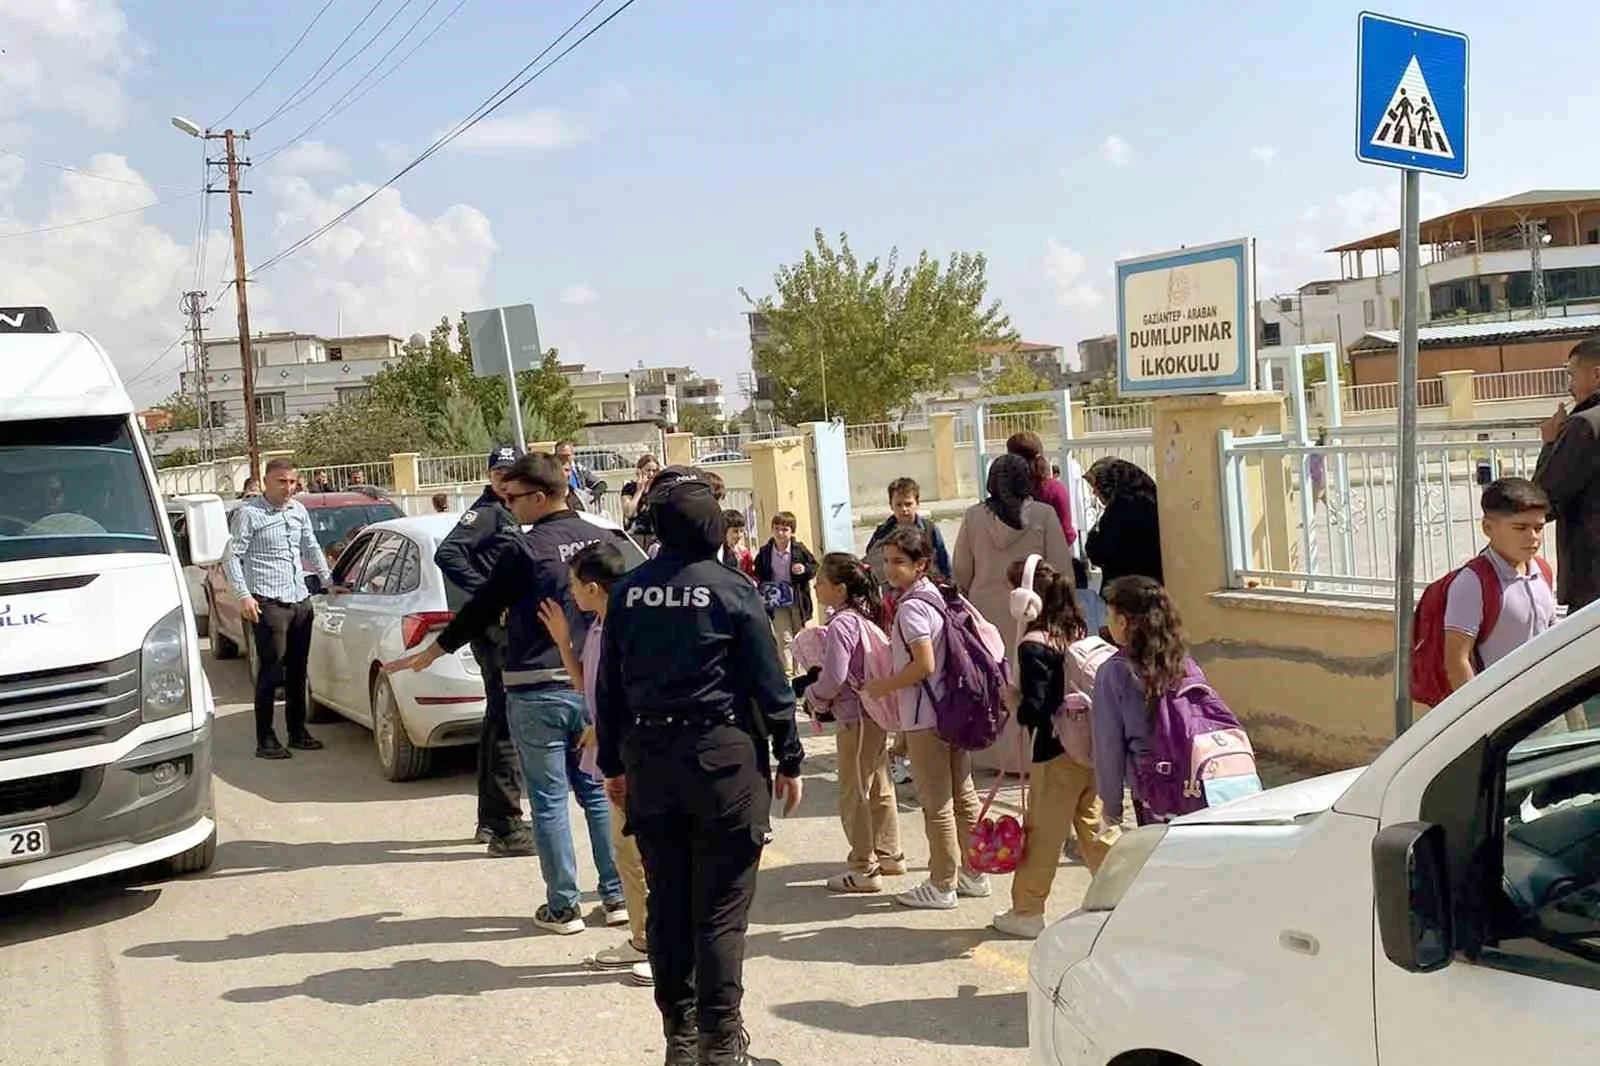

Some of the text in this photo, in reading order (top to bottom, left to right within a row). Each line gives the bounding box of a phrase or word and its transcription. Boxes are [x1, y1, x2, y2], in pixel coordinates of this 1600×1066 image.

[1187, 304, 1217, 320] ARABAN
[1130, 321, 1232, 348] DUMLUPINAR
[1141, 352, 1220, 376] İLKOKULU
[11, 830, 41, 855] 28
